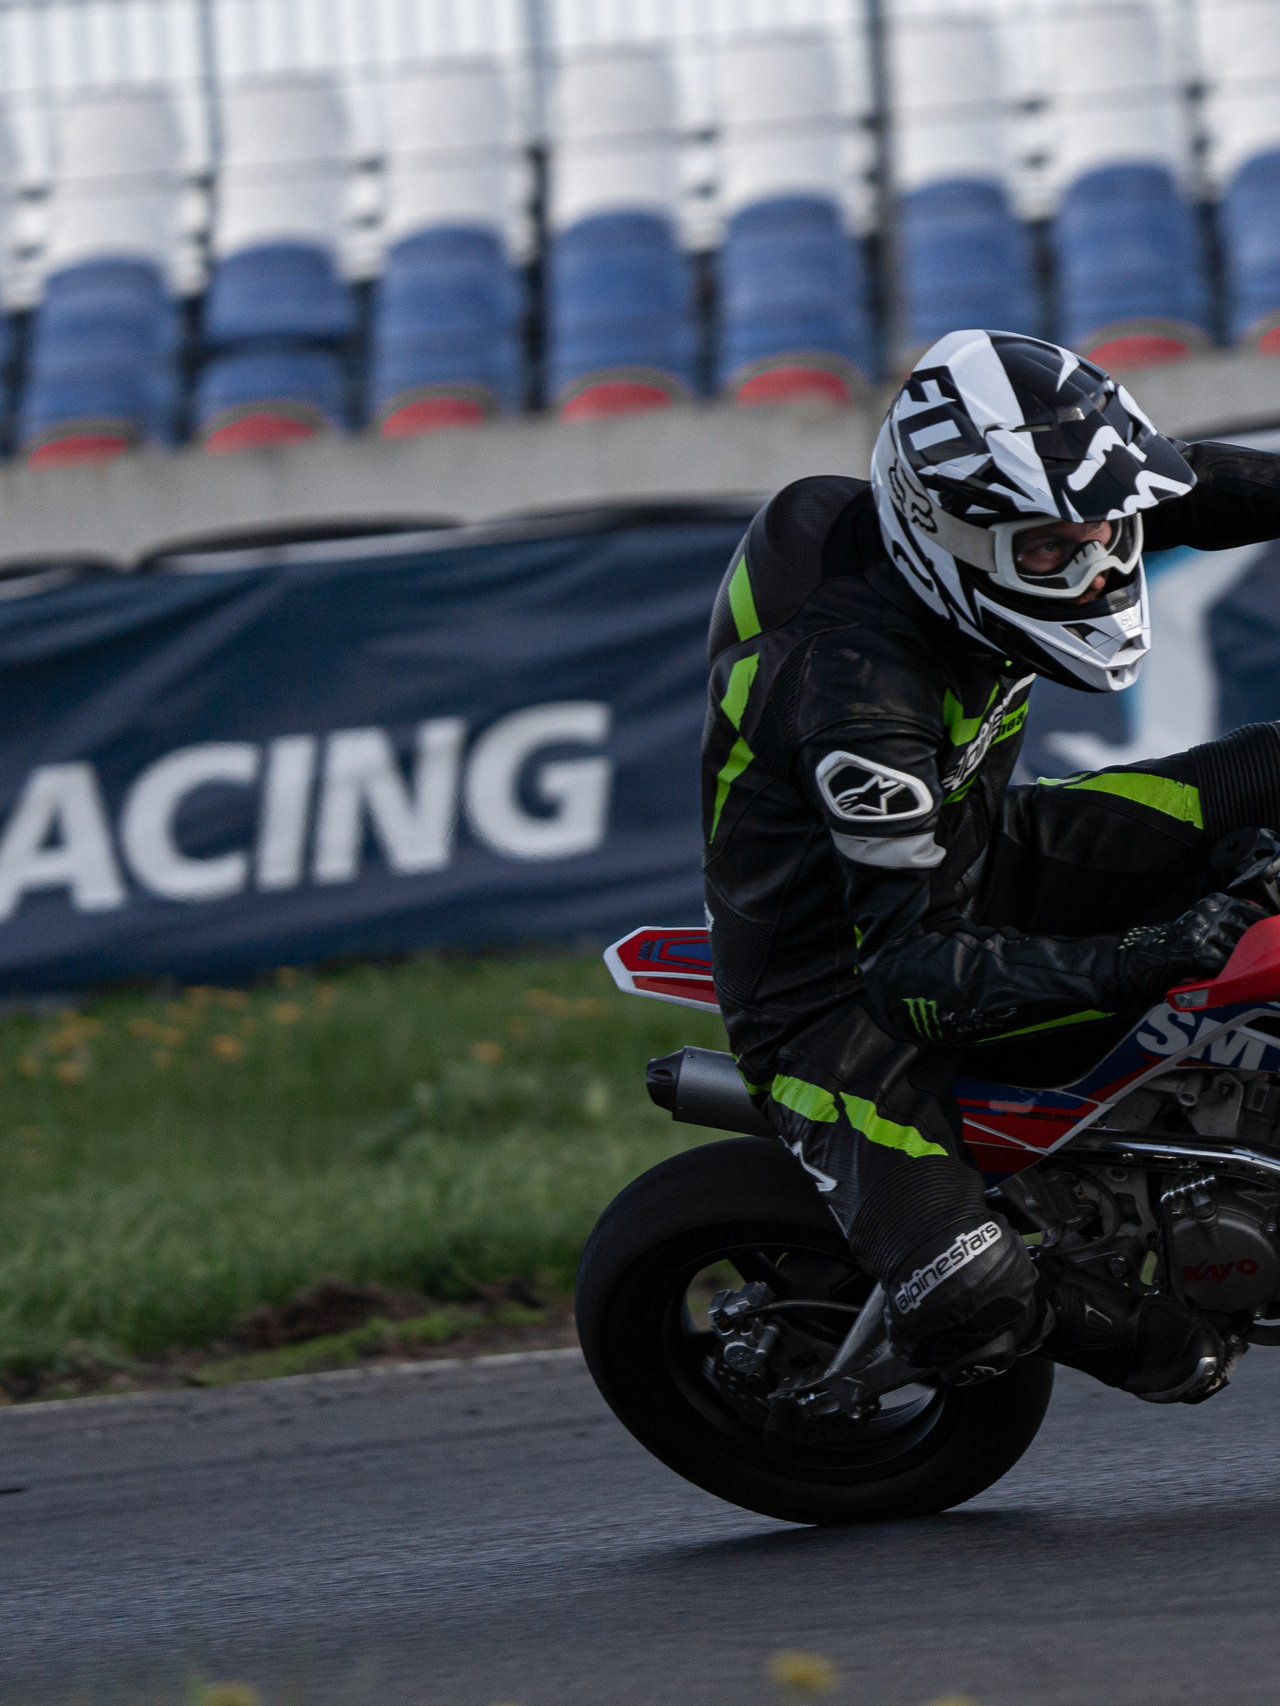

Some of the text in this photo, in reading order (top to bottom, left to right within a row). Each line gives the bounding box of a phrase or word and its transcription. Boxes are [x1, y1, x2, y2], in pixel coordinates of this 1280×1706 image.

[0, 702, 613, 920] ACING
[1136, 1003, 1267, 1070] SM
[898, 1222, 1000, 1313] alpinestars
[1182, 1259, 1258, 1283] KAYO
